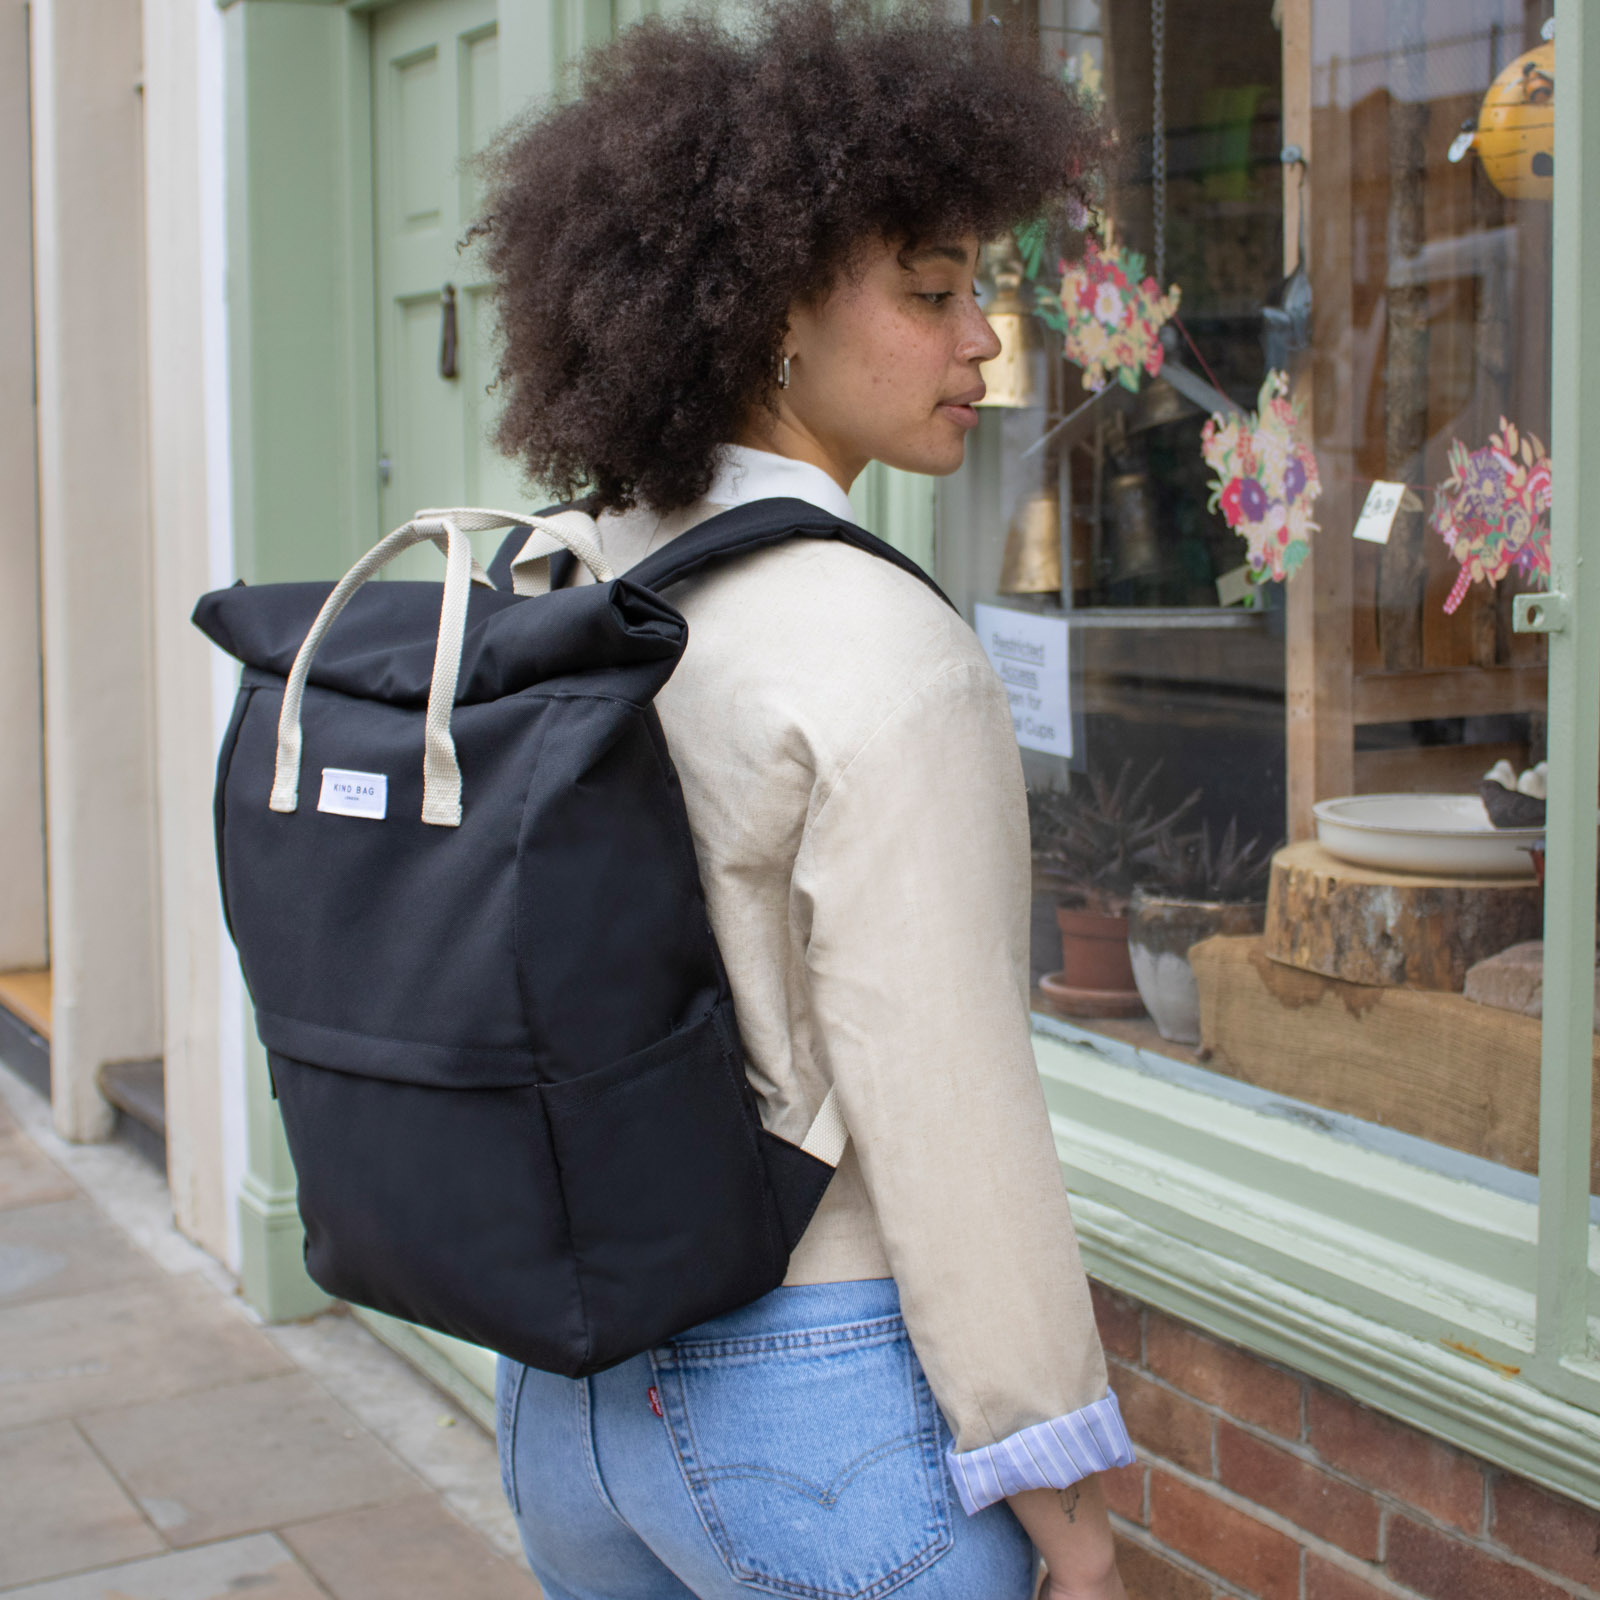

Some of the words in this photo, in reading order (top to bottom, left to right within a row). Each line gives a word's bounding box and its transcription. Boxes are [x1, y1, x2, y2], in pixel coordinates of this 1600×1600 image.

[992, 632, 1044, 660] Restricted
[1000, 661, 1038, 685] Access
[1028, 691, 1041, 711] for
[1025, 716, 1055, 741] Cups
[333, 783, 352, 793] KIND
[356, 786, 375, 796] BAG
